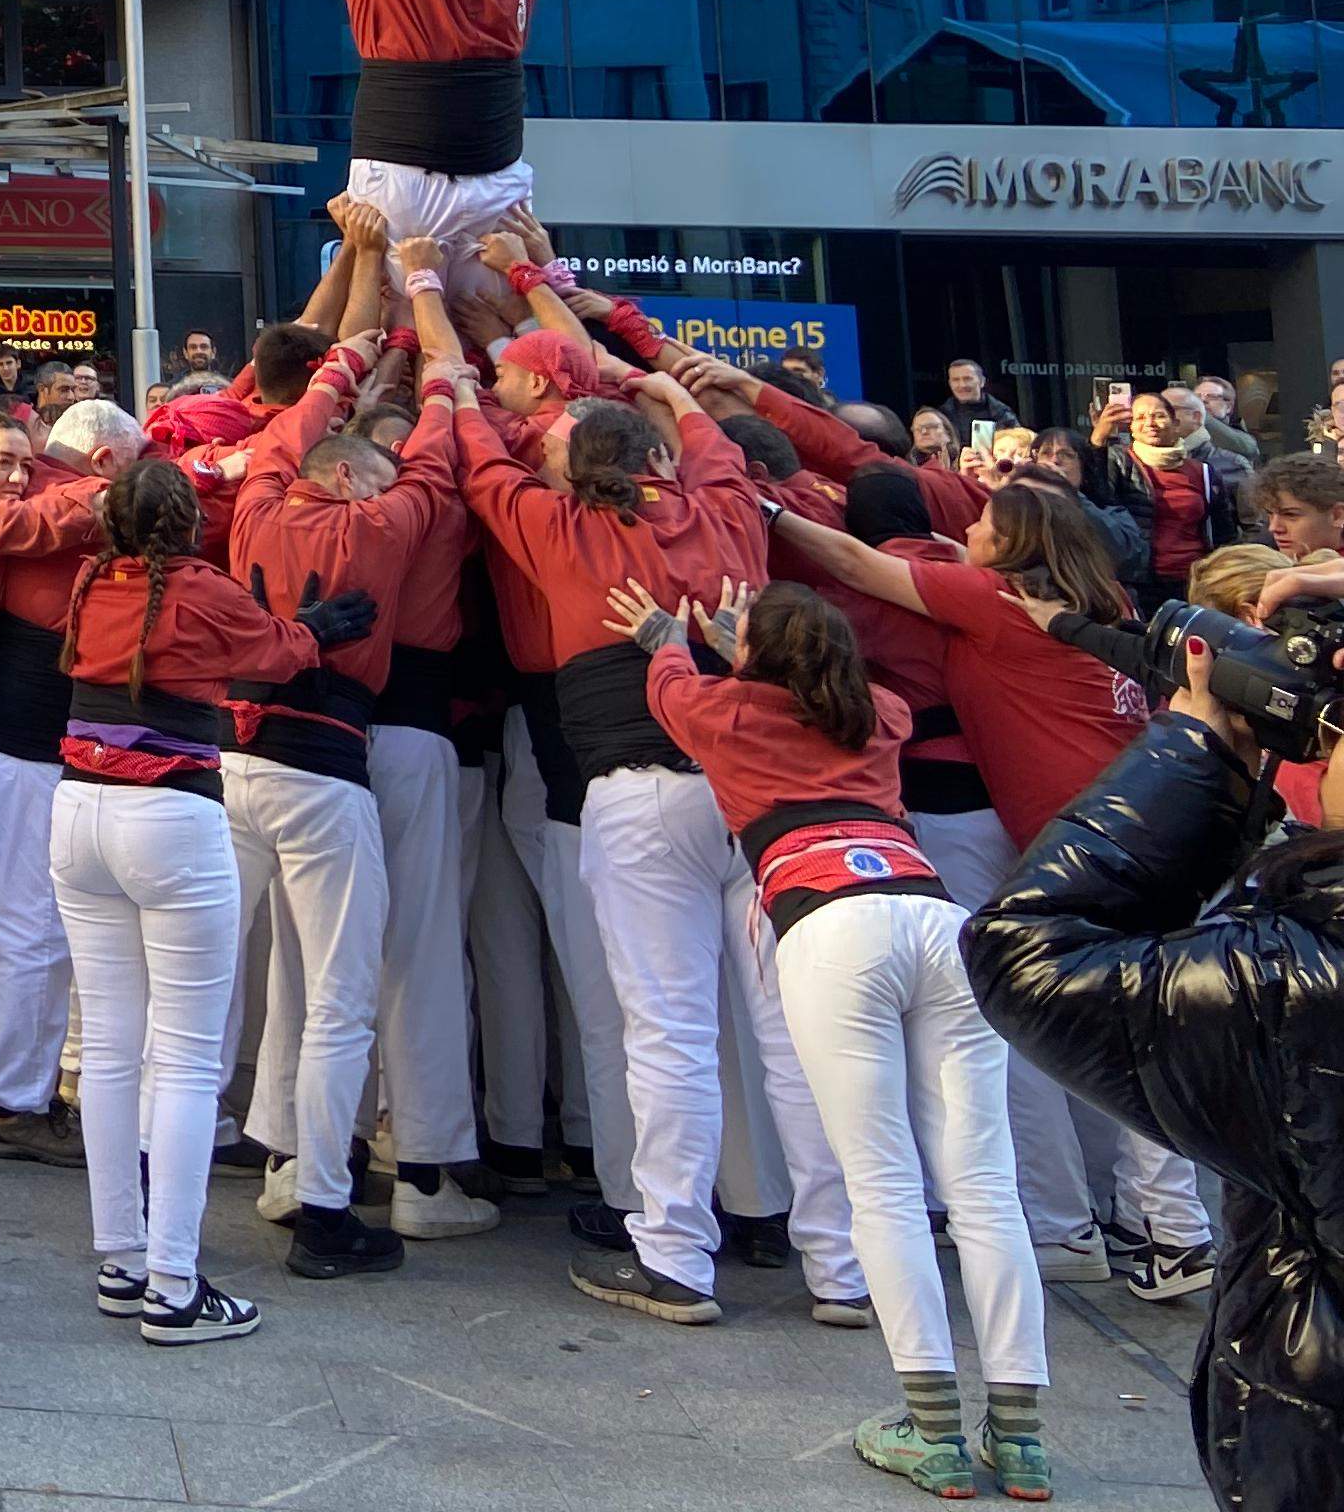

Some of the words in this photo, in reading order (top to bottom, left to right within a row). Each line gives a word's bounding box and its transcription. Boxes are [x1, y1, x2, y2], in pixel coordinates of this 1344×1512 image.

[963, 156, 1334, 212] MORABANC
[586, 258, 599, 271] o
[604, 255, 669, 277] pensió
[675, 259, 687, 273] a
[693, 256, 801, 275] MoraBanc?
[57, 340, 94, 350] 1492
[675, 319, 787, 348] iPhone
[791, 321, 825, 349] 15
